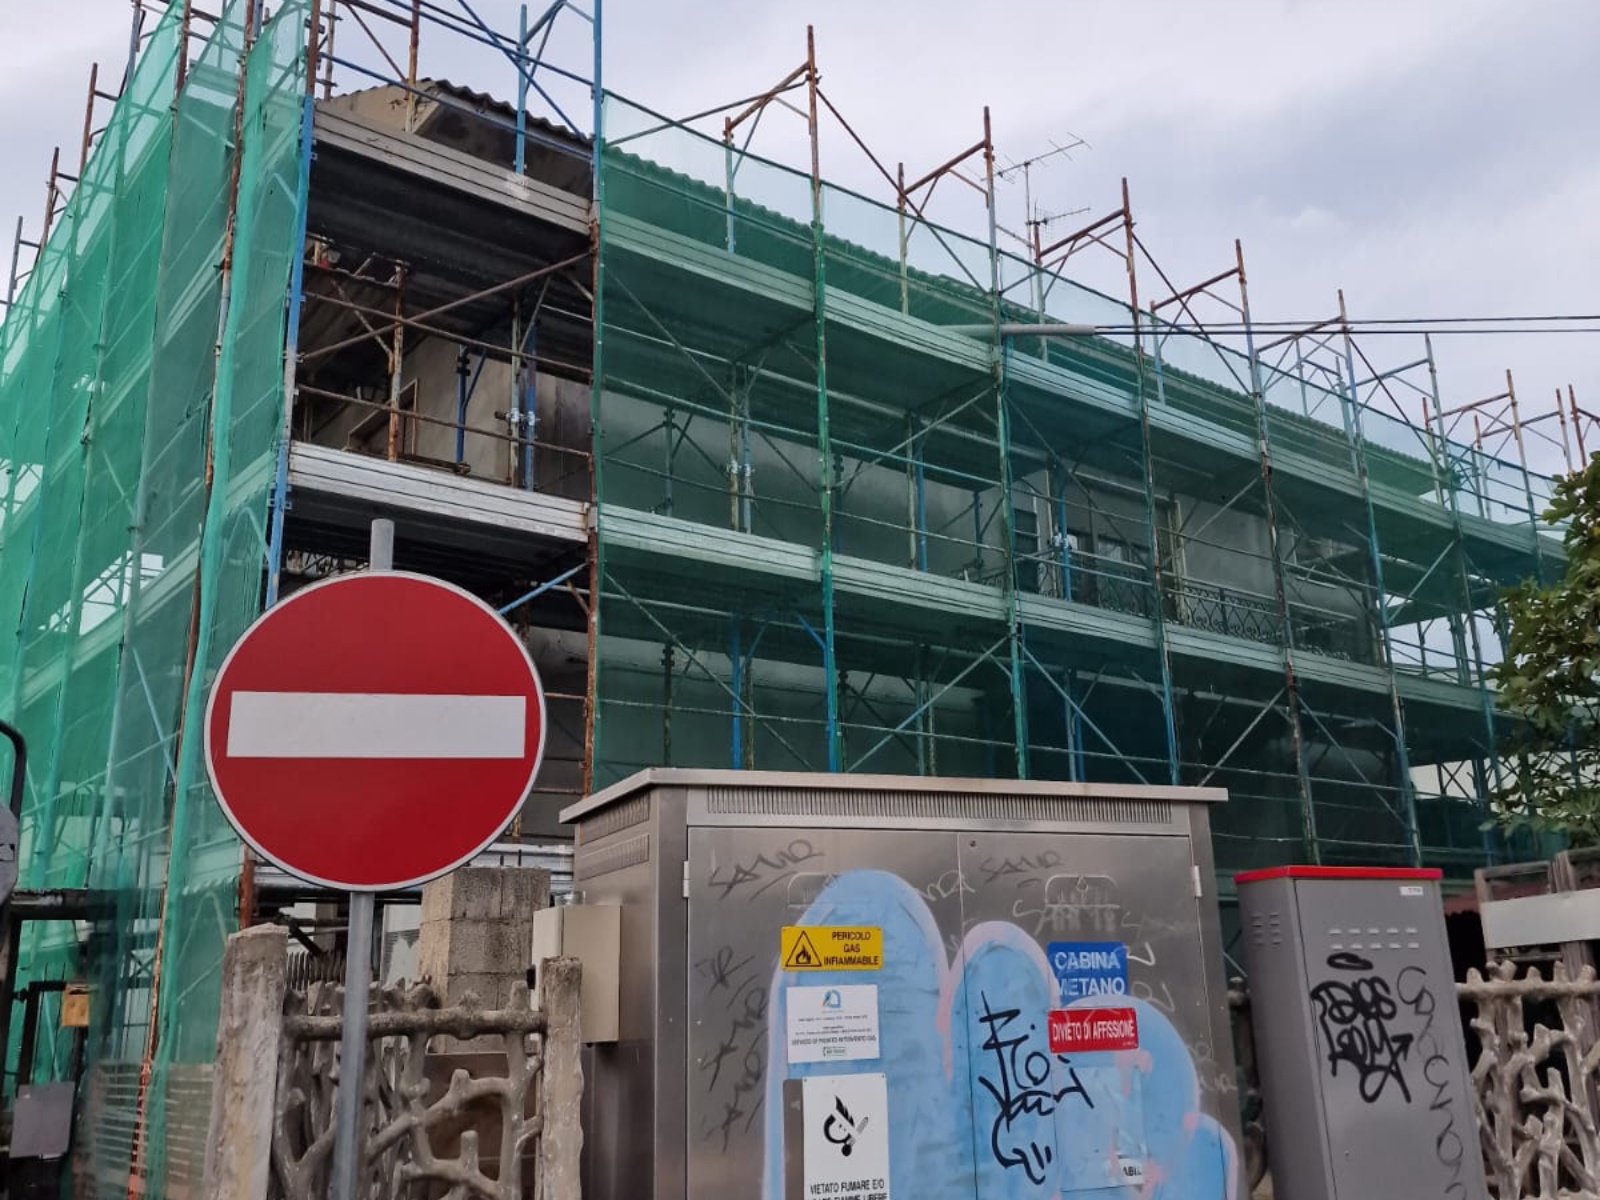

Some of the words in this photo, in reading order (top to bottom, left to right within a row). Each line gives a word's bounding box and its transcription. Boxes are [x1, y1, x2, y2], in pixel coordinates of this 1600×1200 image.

[831, 931, 872, 941] PERICOLO
[843, 943, 861, 953] GAS
[823, 955, 880, 966] INFIAMMABILE
[1055, 951, 1121, 970] CABINA
[1052, 1021, 1082, 1042] DIVIETO
[1083, 1021, 1091, 1041] DI
[1093, 1019, 1136, 1040] AFFISSIONE
[810, 1182, 840, 1195] VIETATO
[840, 1179, 870, 1192] FUMARE
